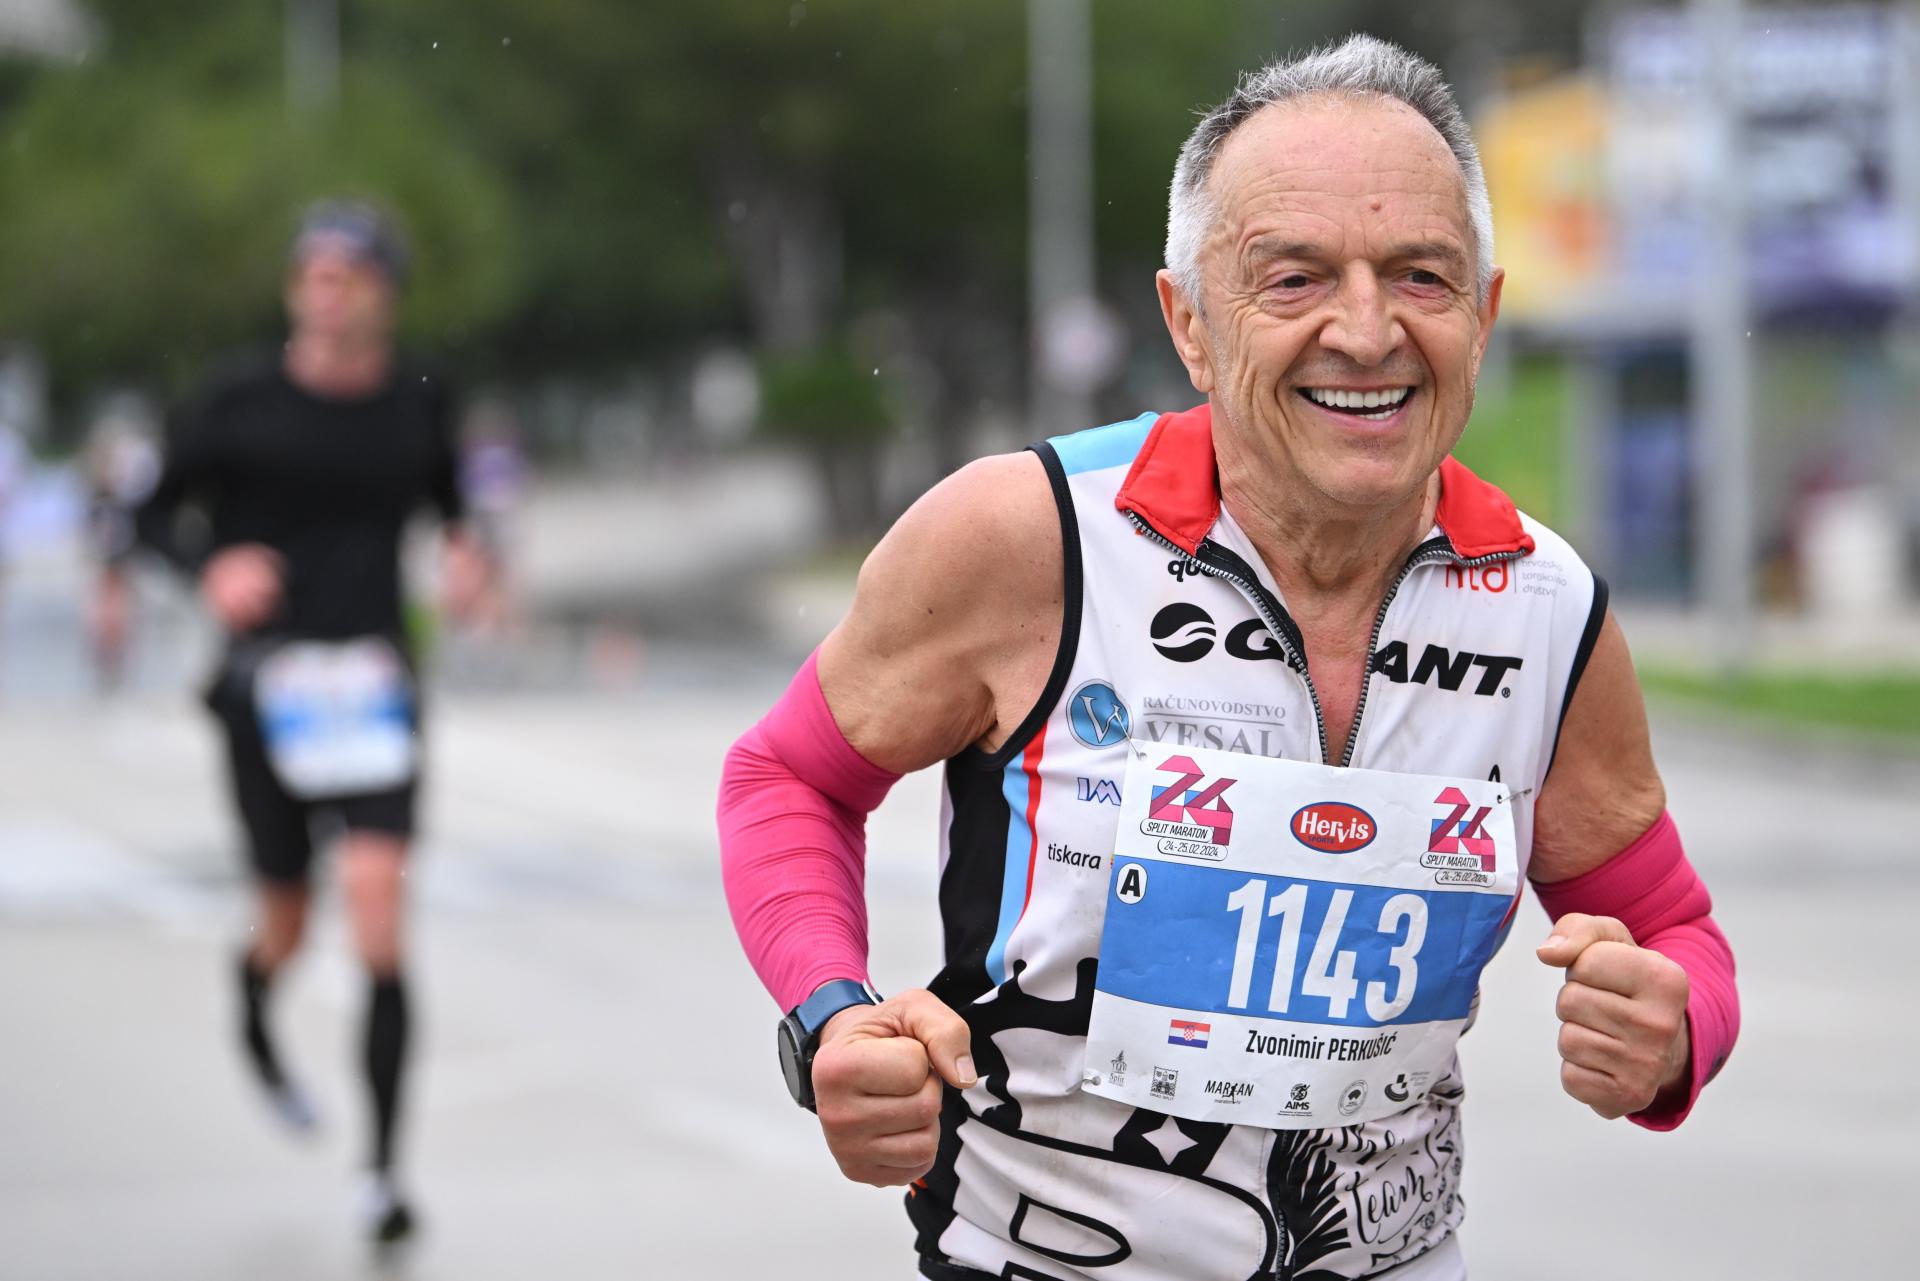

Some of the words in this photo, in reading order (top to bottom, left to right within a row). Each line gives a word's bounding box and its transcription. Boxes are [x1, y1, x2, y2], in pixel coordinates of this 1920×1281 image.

[1224, 618, 1524, 697] GANT
[1143, 694, 1286, 719] RAČUNOVODSTVO
[1145, 720, 1283, 759] VESAL
[1147, 821, 1168, 834] SPLIT
[1169, 825, 1208, 840] MARATON
[1299, 810, 1369, 843] Hervis
[1048, 844, 1102, 870] tiskara
[1426, 854, 1446, 865] SPLIT
[1447, 856, 1478, 868] MARATON
[1120, 868, 1141, 898] A
[1226, 878, 1429, 1022] 1143
[1246, 1029, 1325, 1060] Zvonimir
[1284, 1100, 1310, 1110] AIMS
